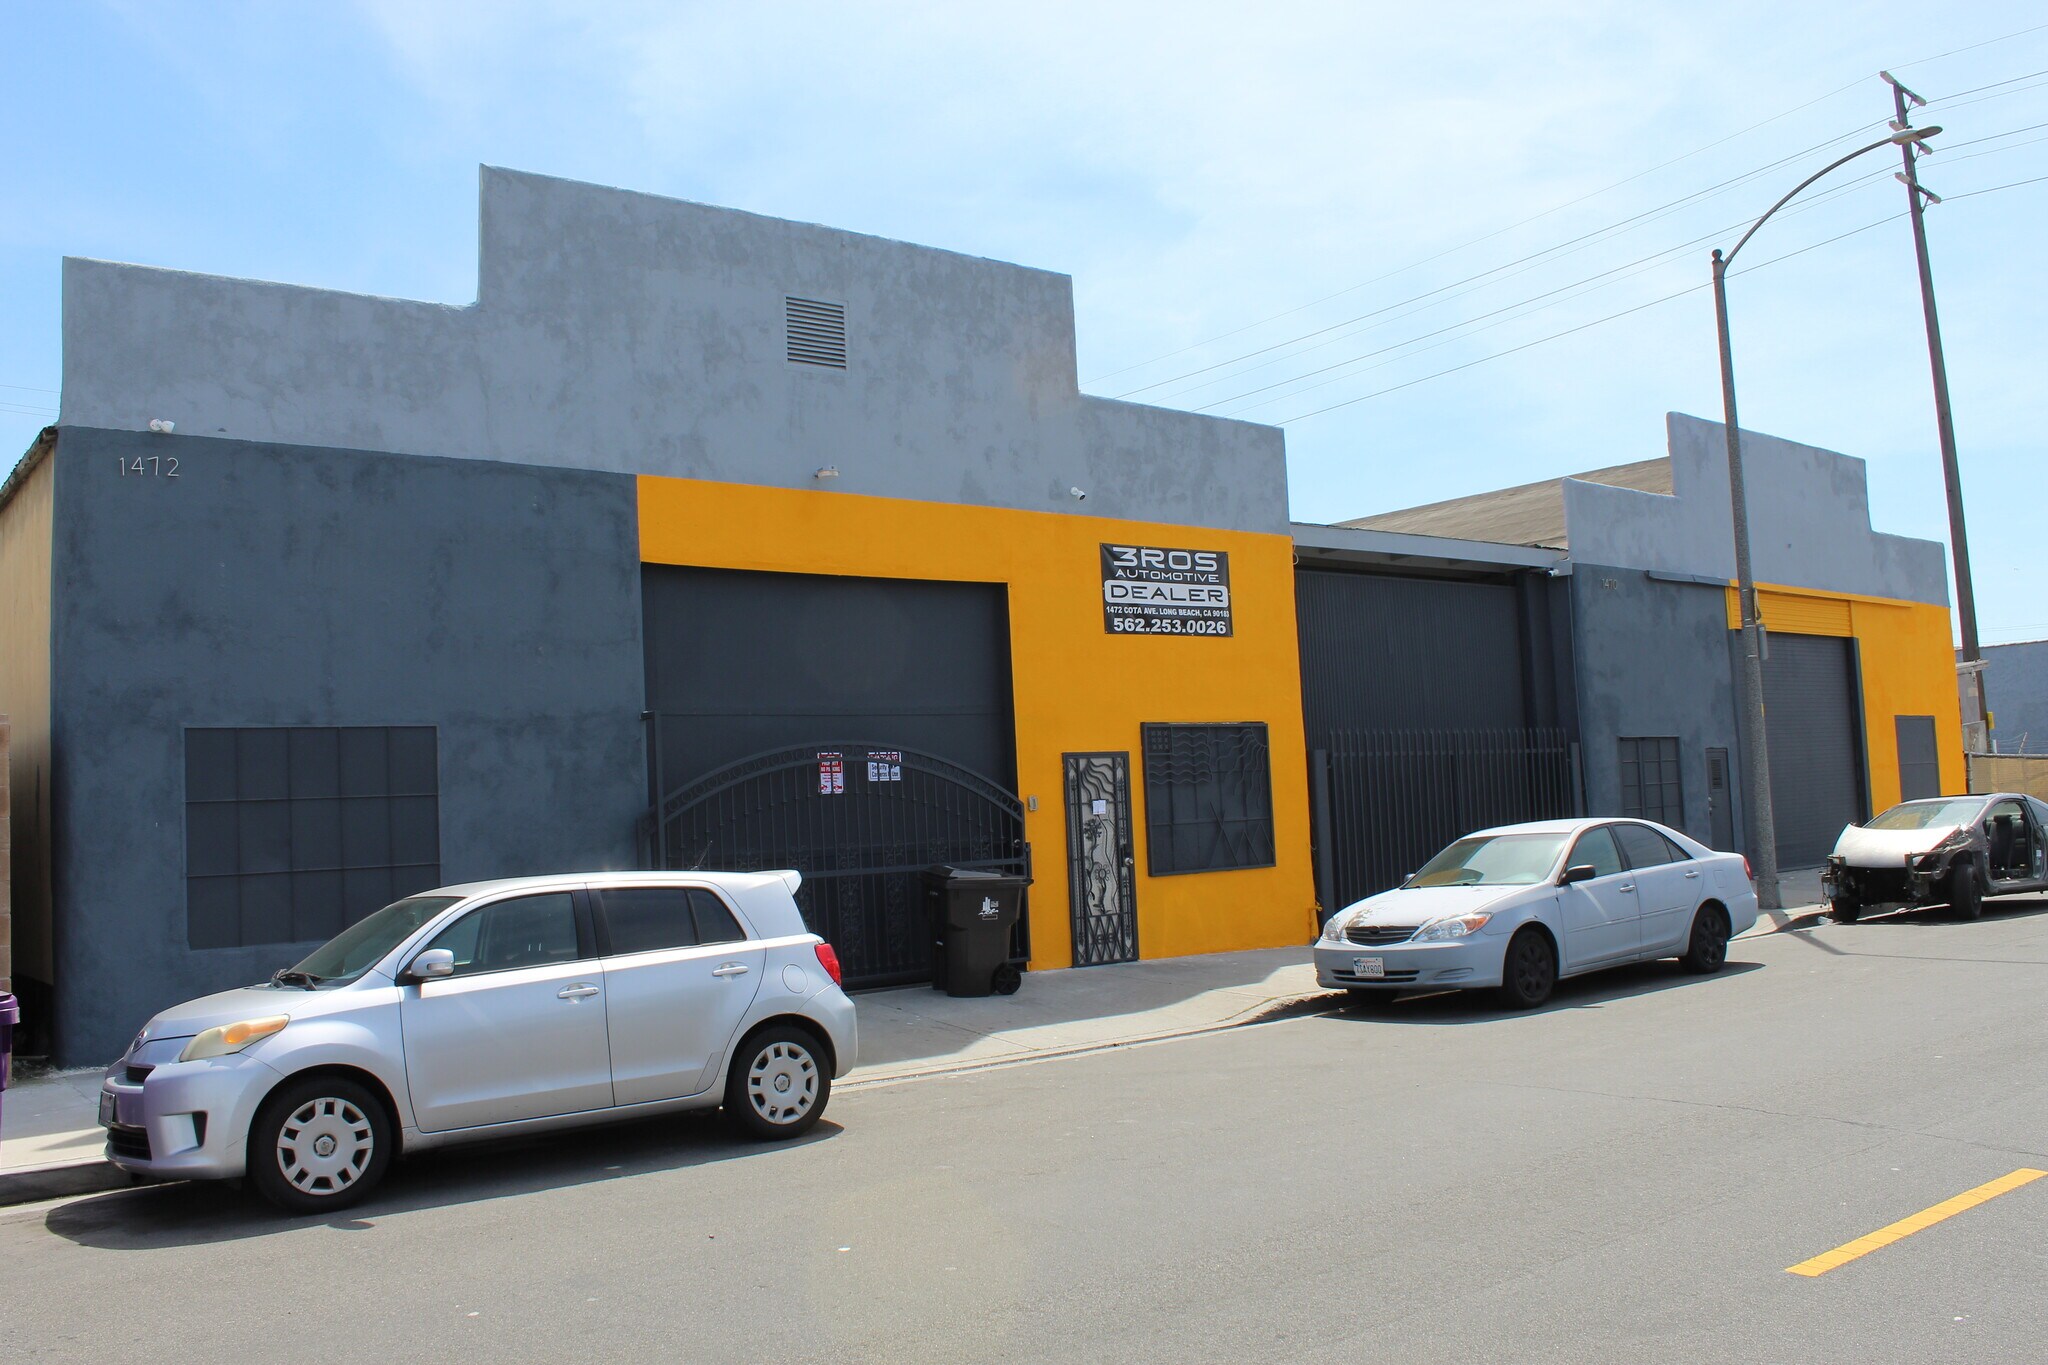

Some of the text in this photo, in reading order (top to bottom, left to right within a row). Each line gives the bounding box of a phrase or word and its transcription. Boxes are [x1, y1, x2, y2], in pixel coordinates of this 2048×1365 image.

[119, 456, 180, 477] 1472
[1112, 547, 1218, 571] 3ROS
[1115, 569, 1219, 582] AUTOMOTIVE
[1111, 585, 1223, 602] DEALER
[1106, 605, 1123, 614] 1472
[1123, 606, 1142, 614] COTA
[1143, 607, 1159, 615] AVE.
[1159, 607, 1178, 616] LONG
[1178, 608, 1203, 618] BEACH,
[1203, 609, 1212, 617] CA
[1113, 617, 1227, 634] 562.253.0026
